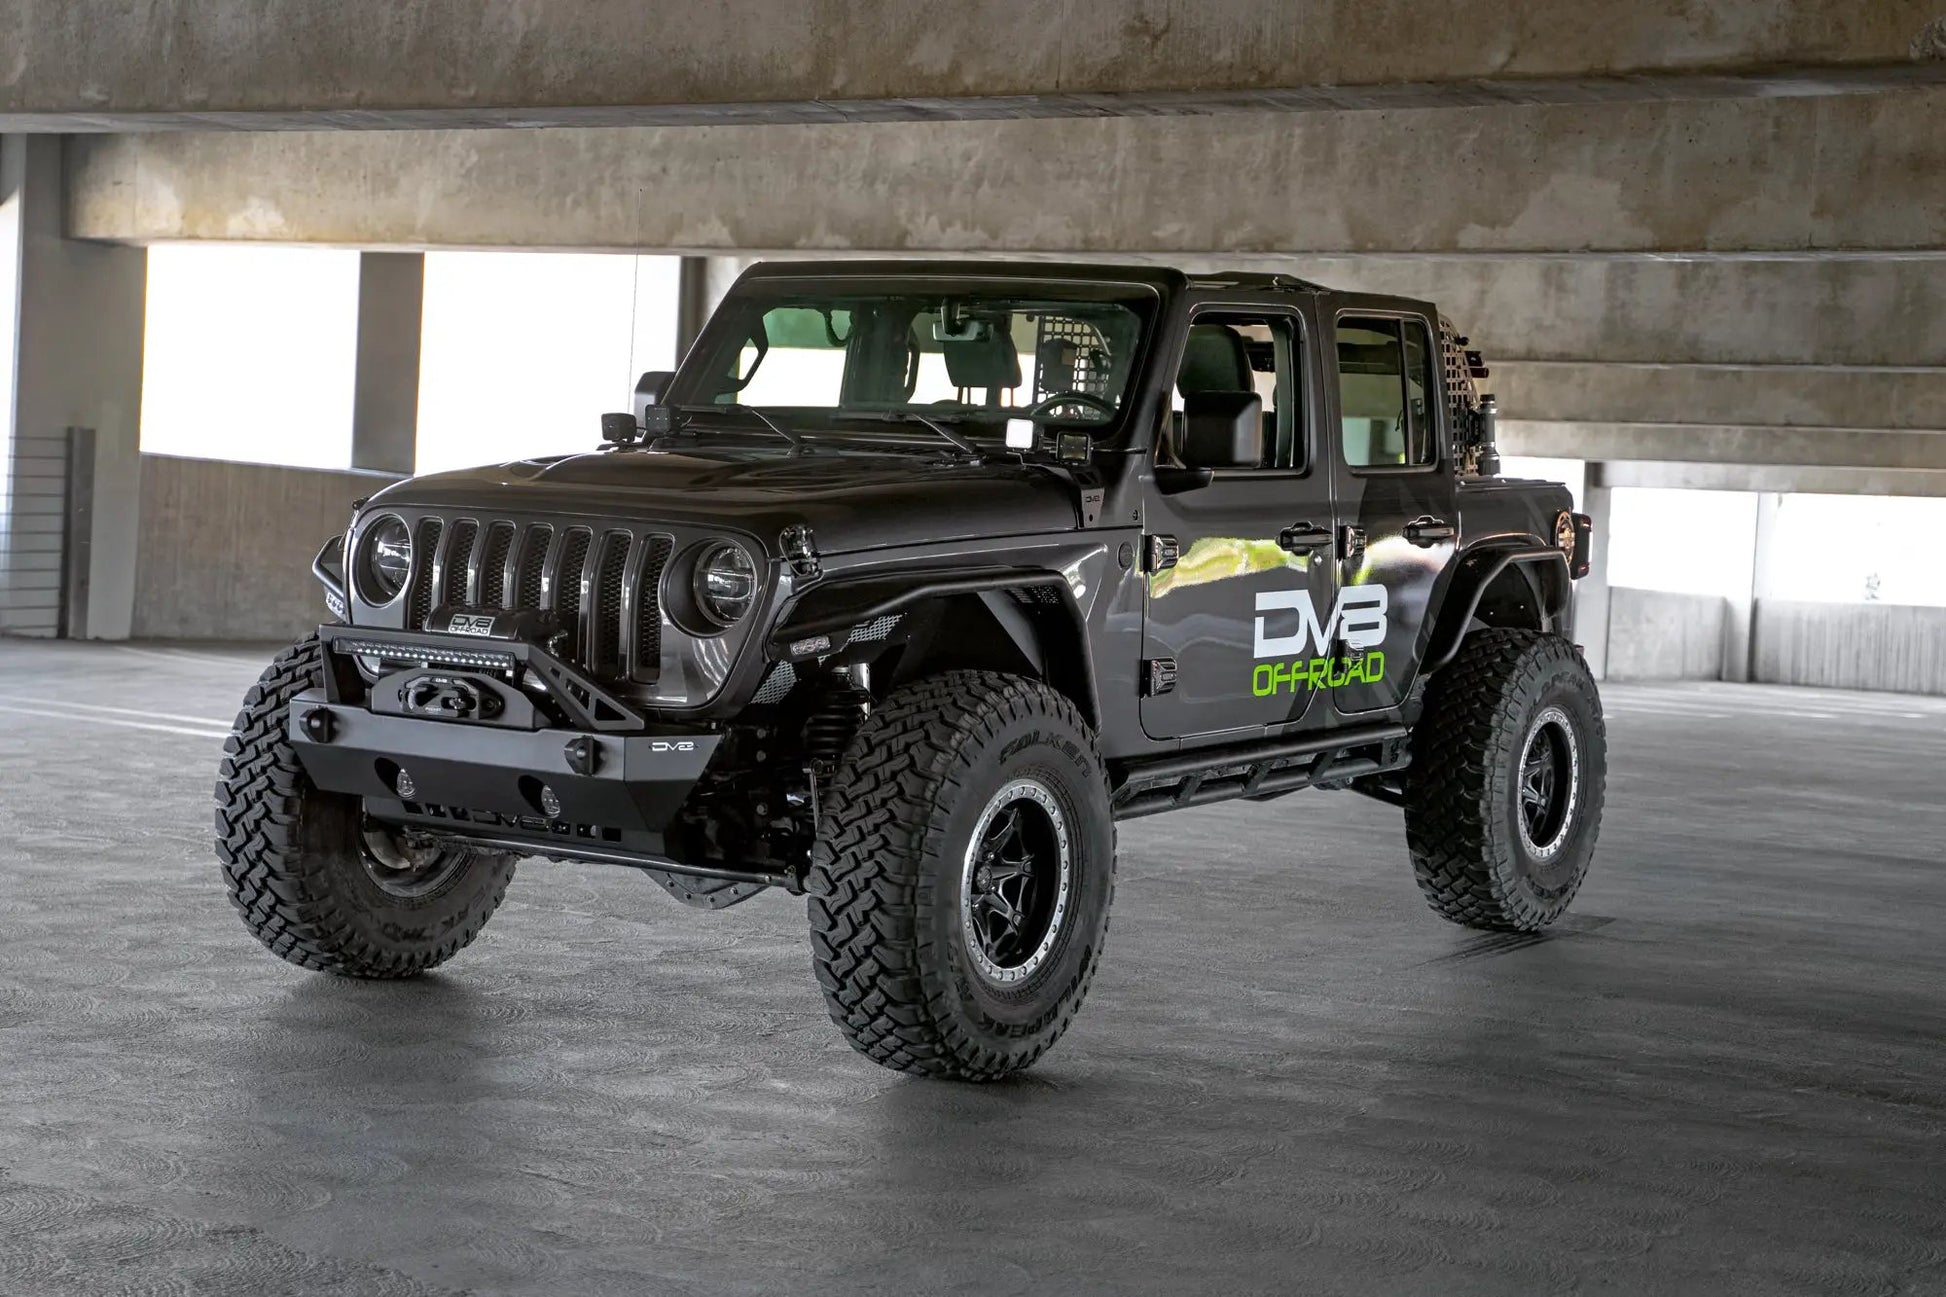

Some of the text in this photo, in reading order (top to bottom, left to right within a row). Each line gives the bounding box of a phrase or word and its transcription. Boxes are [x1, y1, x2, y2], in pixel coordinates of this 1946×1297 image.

[452, 615, 492, 628] DV8
[1254, 584, 1388, 658] DV8
[651, 741, 694, 751] DV8
